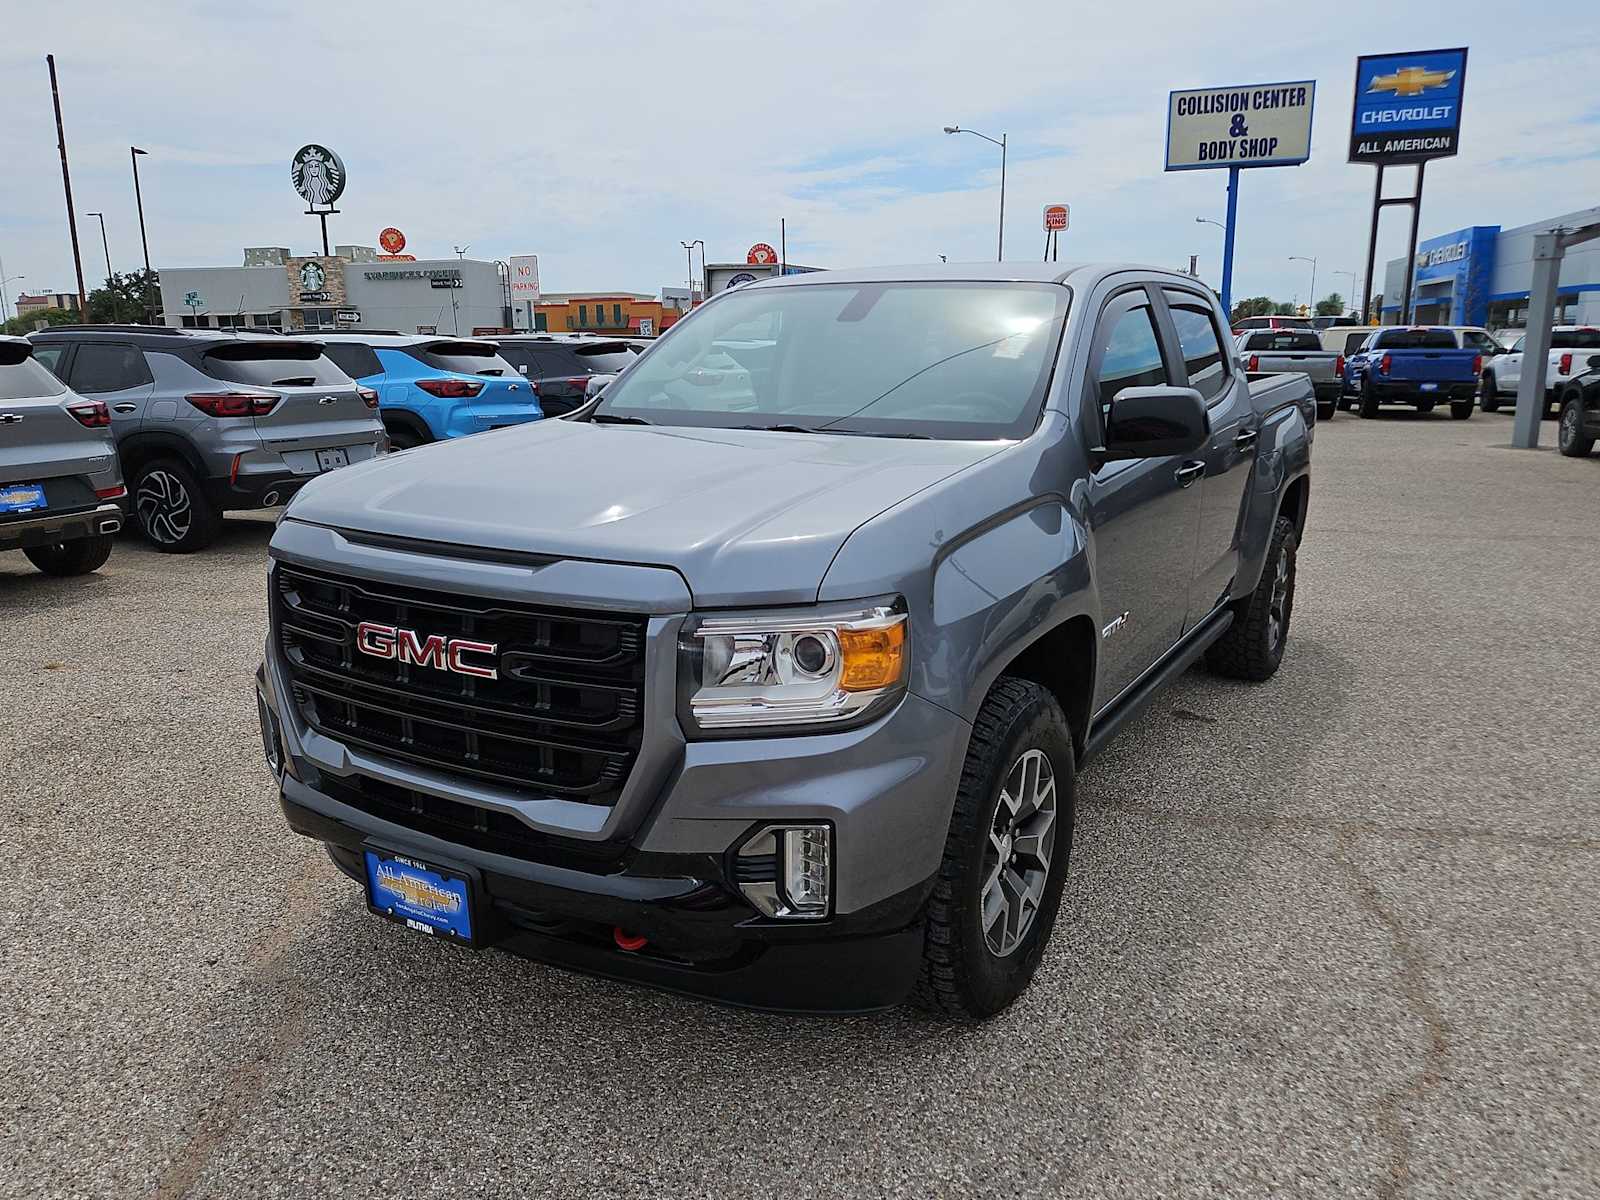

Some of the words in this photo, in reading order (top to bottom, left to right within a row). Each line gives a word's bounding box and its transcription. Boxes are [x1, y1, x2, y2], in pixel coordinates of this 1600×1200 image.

[1177, 92, 1249, 116] COLLISION
[1252, 87, 1306, 110] CENTER
[1229, 113, 1248, 138] &
[1361, 106, 1452, 124] CHEVROLET
[1198, 140, 1237, 161] BODY
[1240, 137, 1278, 158] SHOP
[1357, 141, 1381, 154] ALL
[1384, 137, 1450, 152] AMERICAN
[1046, 218, 1067, 226] KING
[1430, 240, 1470, 266] CHEVROLET
[518, 266, 531, 276] NO
[513, 282, 538, 290] PARKING
[357, 621, 497, 680] GMC
[376, 863, 394, 880] All
[401, 872, 463, 903] American
